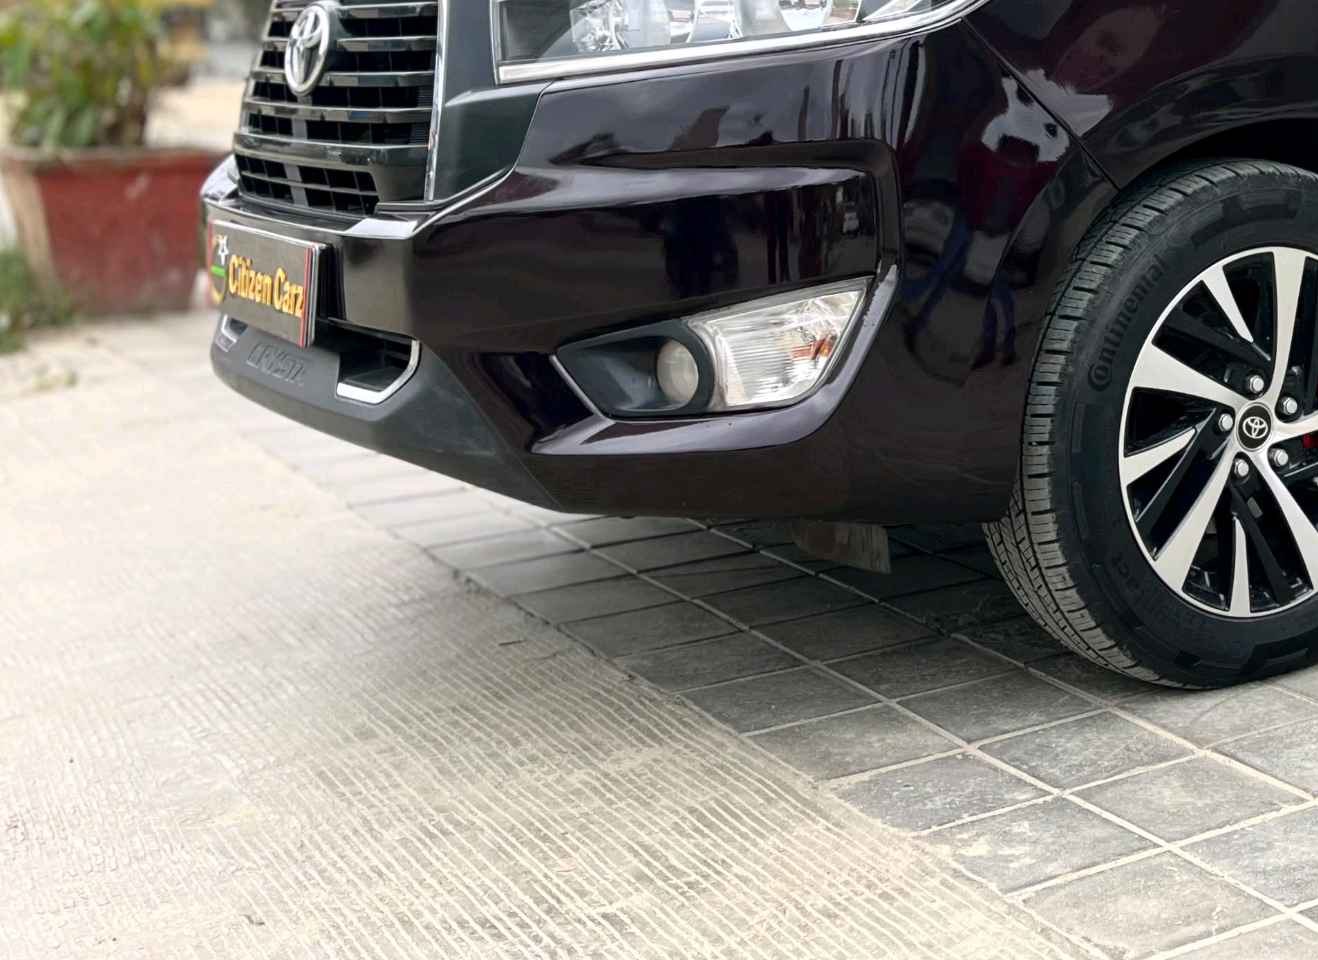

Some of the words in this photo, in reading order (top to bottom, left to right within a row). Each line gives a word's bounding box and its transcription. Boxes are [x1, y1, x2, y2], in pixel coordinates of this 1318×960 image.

[228, 254, 273, 305] Citizen
[273, 268, 305, 318] Carz
[1088, 255, 1167, 391] Continental
